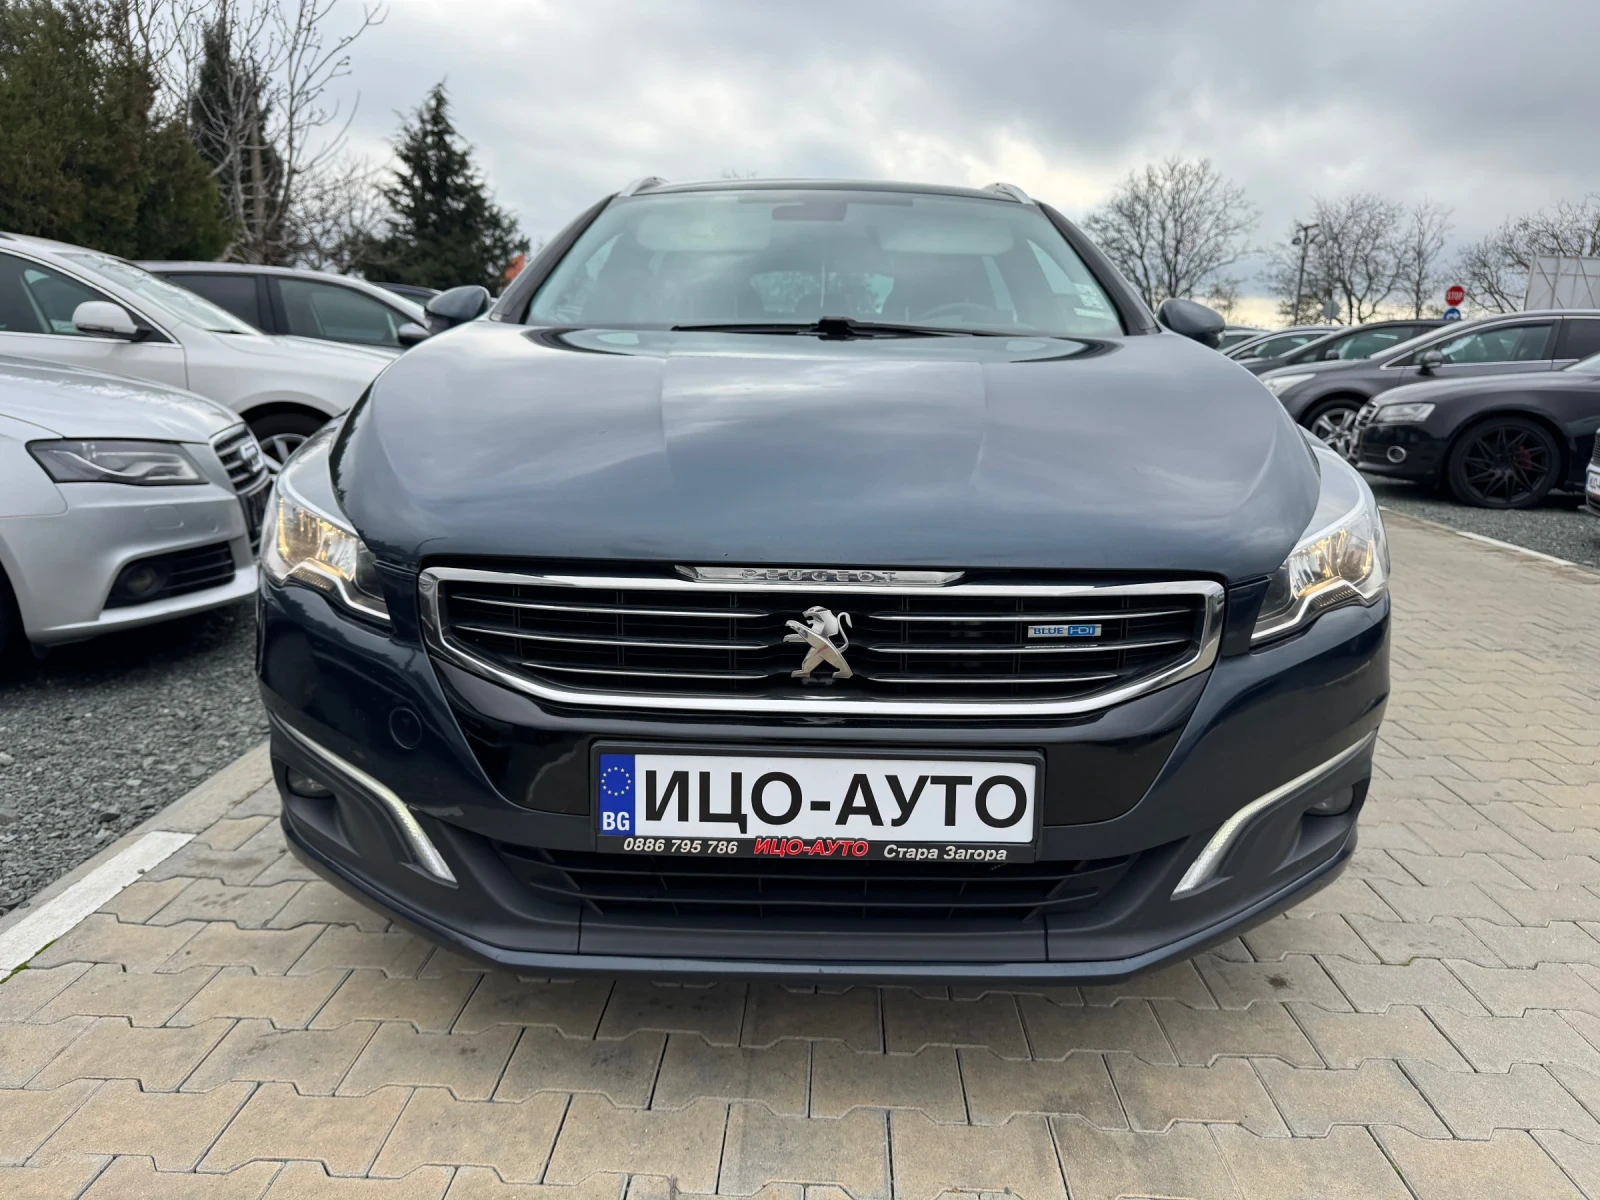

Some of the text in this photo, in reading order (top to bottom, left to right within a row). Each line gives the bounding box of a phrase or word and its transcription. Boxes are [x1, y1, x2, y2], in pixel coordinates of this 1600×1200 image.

[1447, 291, 1463, 301] STOP
[740, 569, 897, 583] PEUGEOT
[1033, 626, 1093, 635] BLUE HDI
[645, 769, 1028, 834] ИЦО-АУТО
[602, 811, 630, 831] BG
[623, 837, 738, 855] 0886 795 786
[753, 838, 869, 857] ИЦО-АУТО
[883, 844, 1007, 861] Стара Загора
